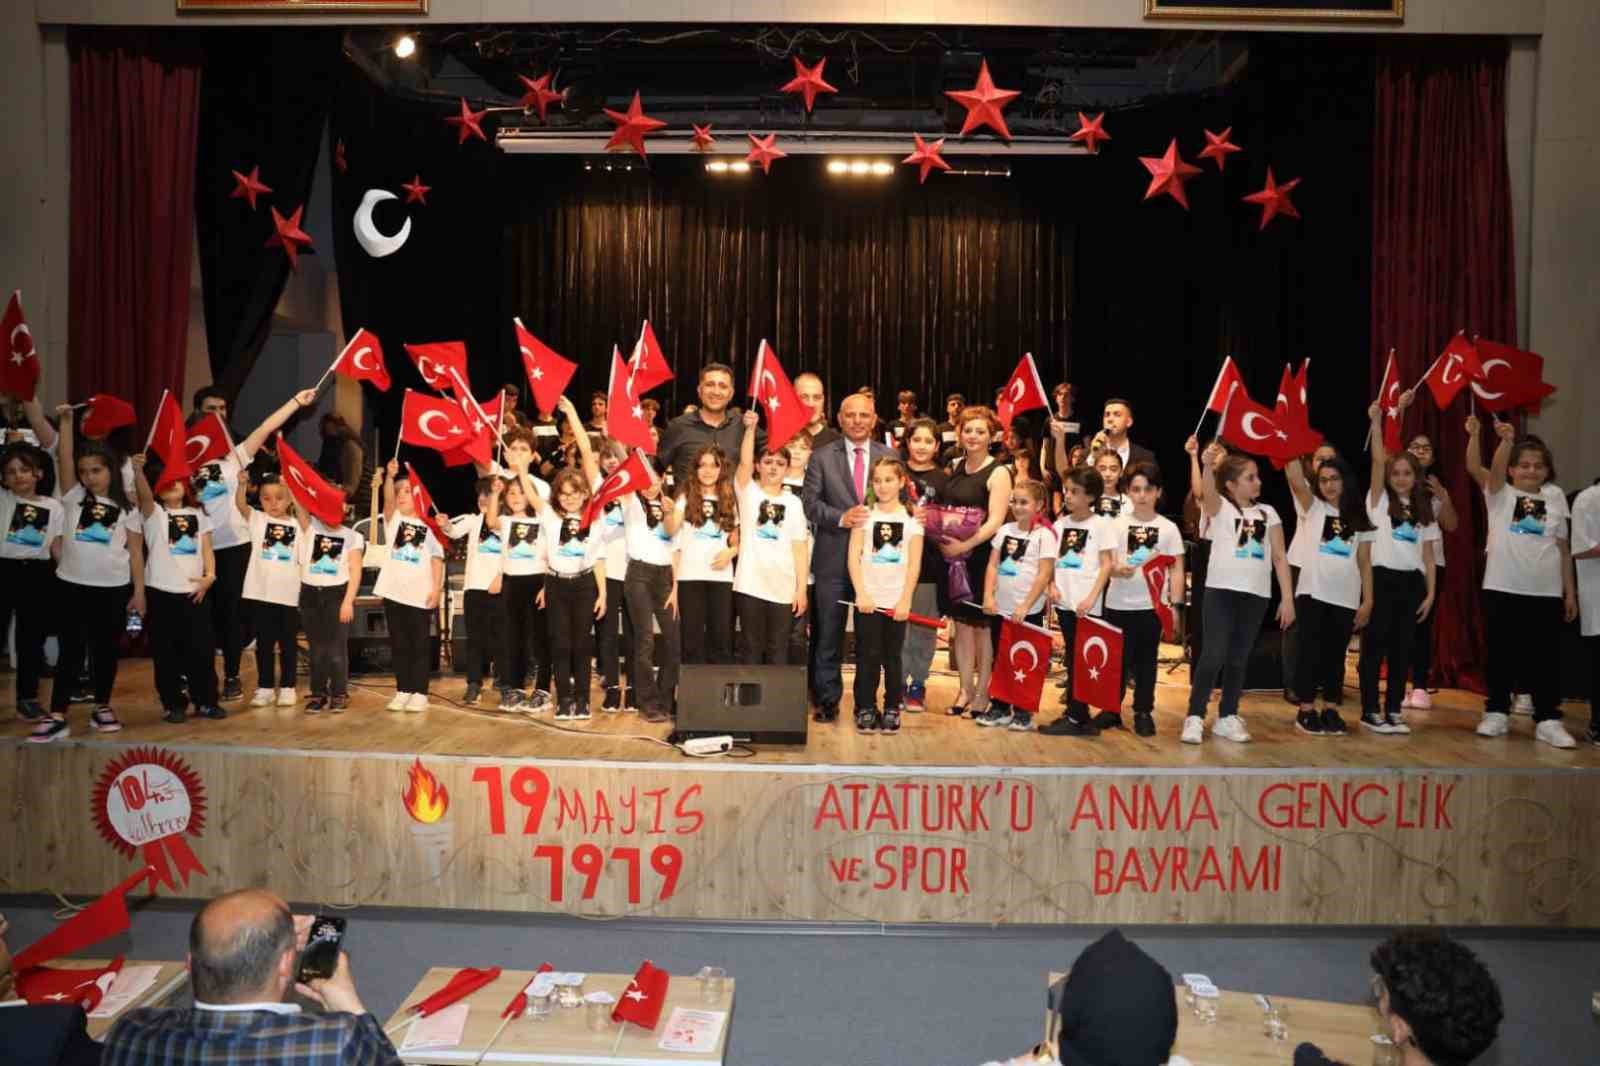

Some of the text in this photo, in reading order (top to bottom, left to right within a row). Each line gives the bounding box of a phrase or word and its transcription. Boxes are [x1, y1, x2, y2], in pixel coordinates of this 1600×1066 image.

[472, 766, 705, 835] 19 MAYIS
[1069, 783, 1220, 831] ANMA
[533, 844, 683, 904] 1919
[873, 845, 970, 894] SPOR
[1093, 845, 1281, 896] BAYRAMI
